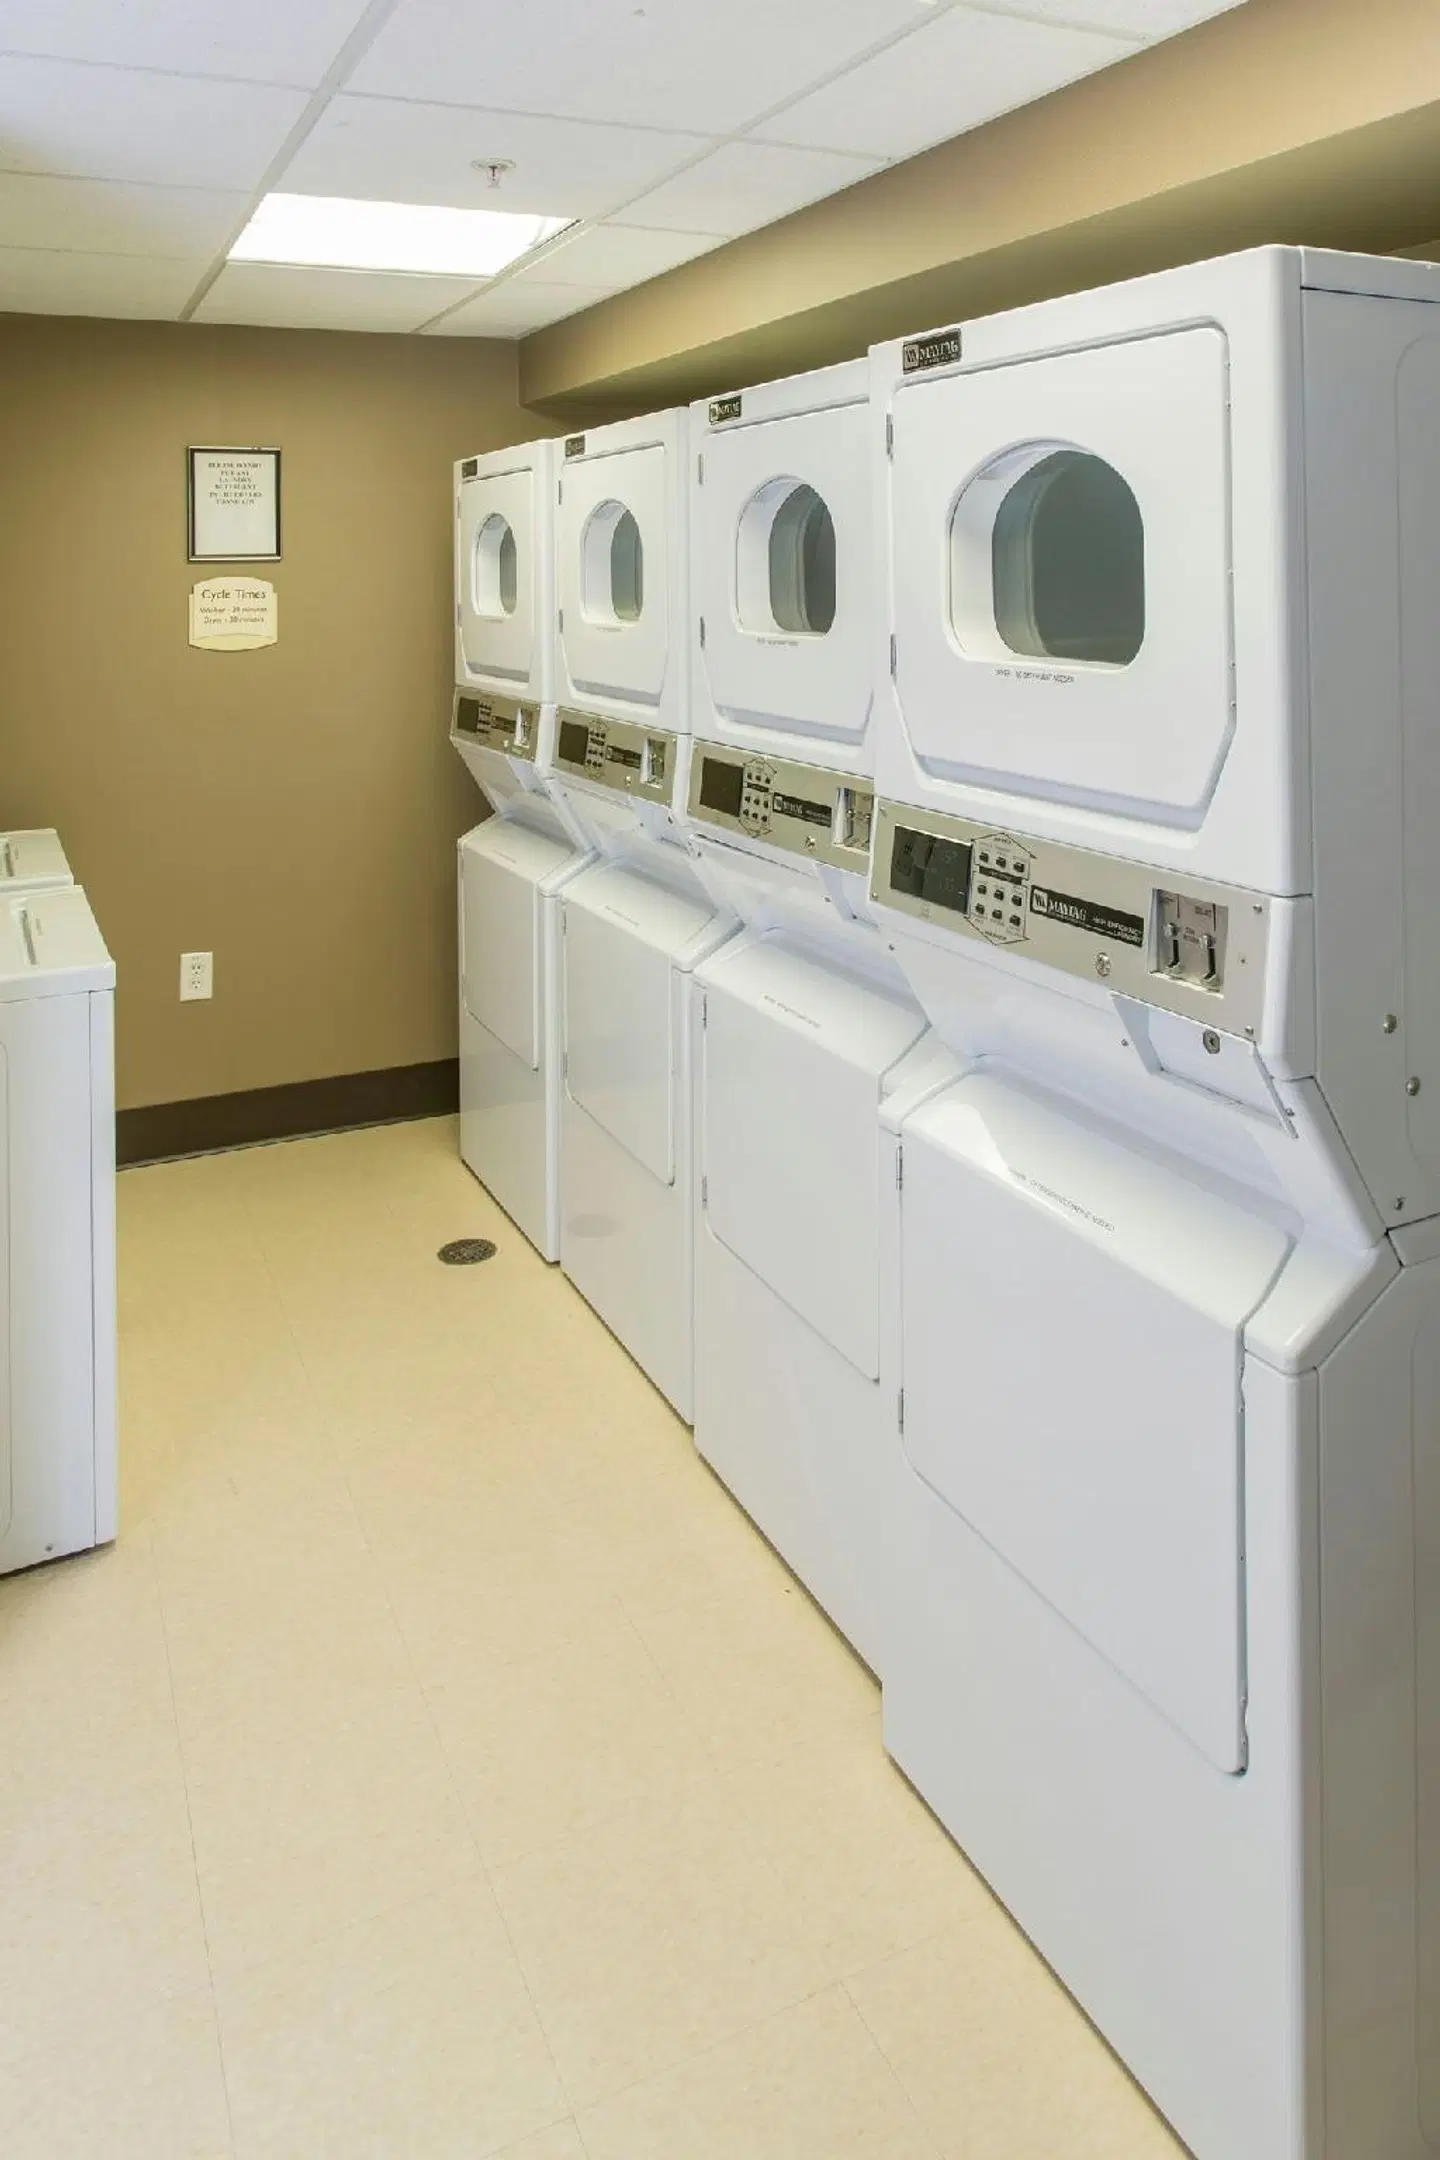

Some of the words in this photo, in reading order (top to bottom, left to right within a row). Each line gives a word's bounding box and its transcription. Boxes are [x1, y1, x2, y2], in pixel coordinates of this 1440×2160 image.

[201, 589, 231, 602] Cycle
[234, 589, 266, 600] Times
[1047, 899, 1087, 922] MAYTAG
